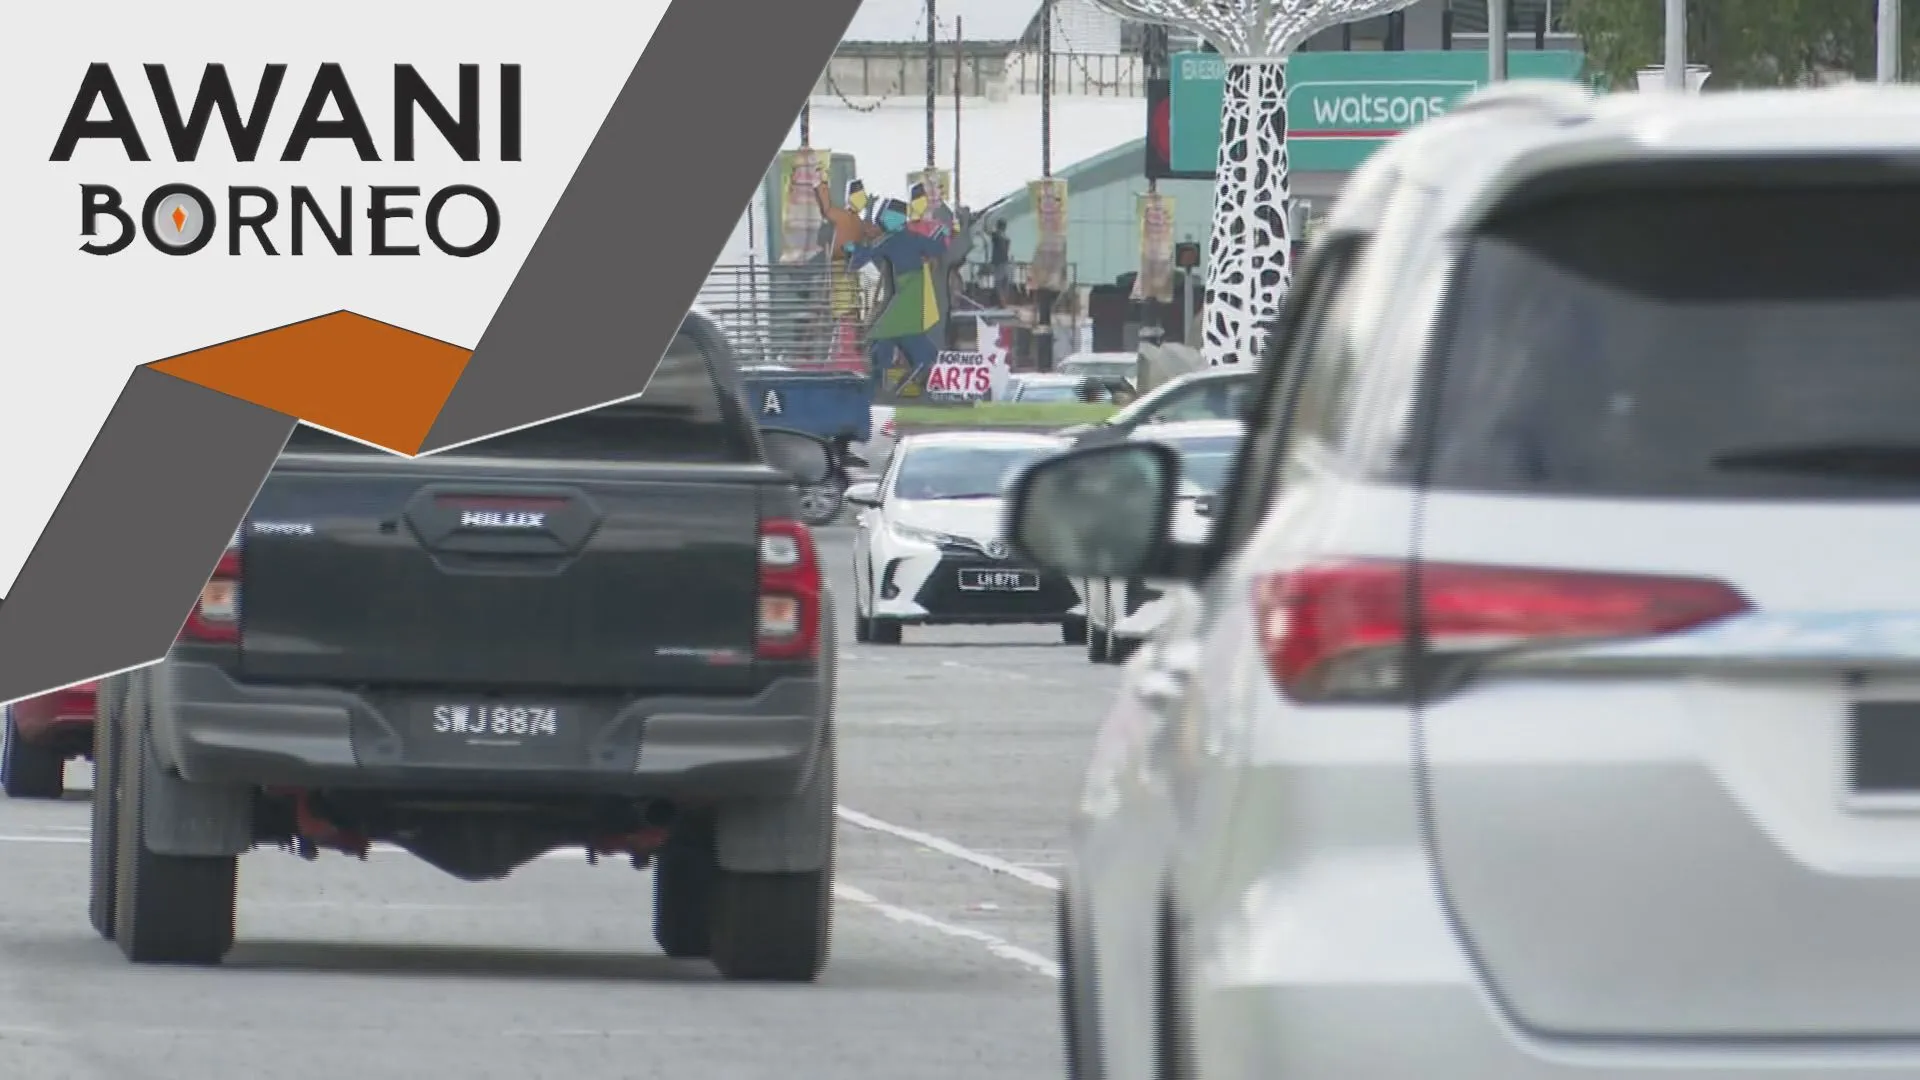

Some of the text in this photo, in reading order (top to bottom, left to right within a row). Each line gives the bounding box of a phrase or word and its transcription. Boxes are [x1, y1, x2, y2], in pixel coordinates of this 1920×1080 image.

[1313, 94, 1445, 124] watsons
[939, 353, 983, 365] BORNEO
[928, 366, 990, 392] ARTS
[763, 389, 781, 414] A
[460, 511, 545, 528] HILUX
[433, 704, 557, 736] SWJ 8874
